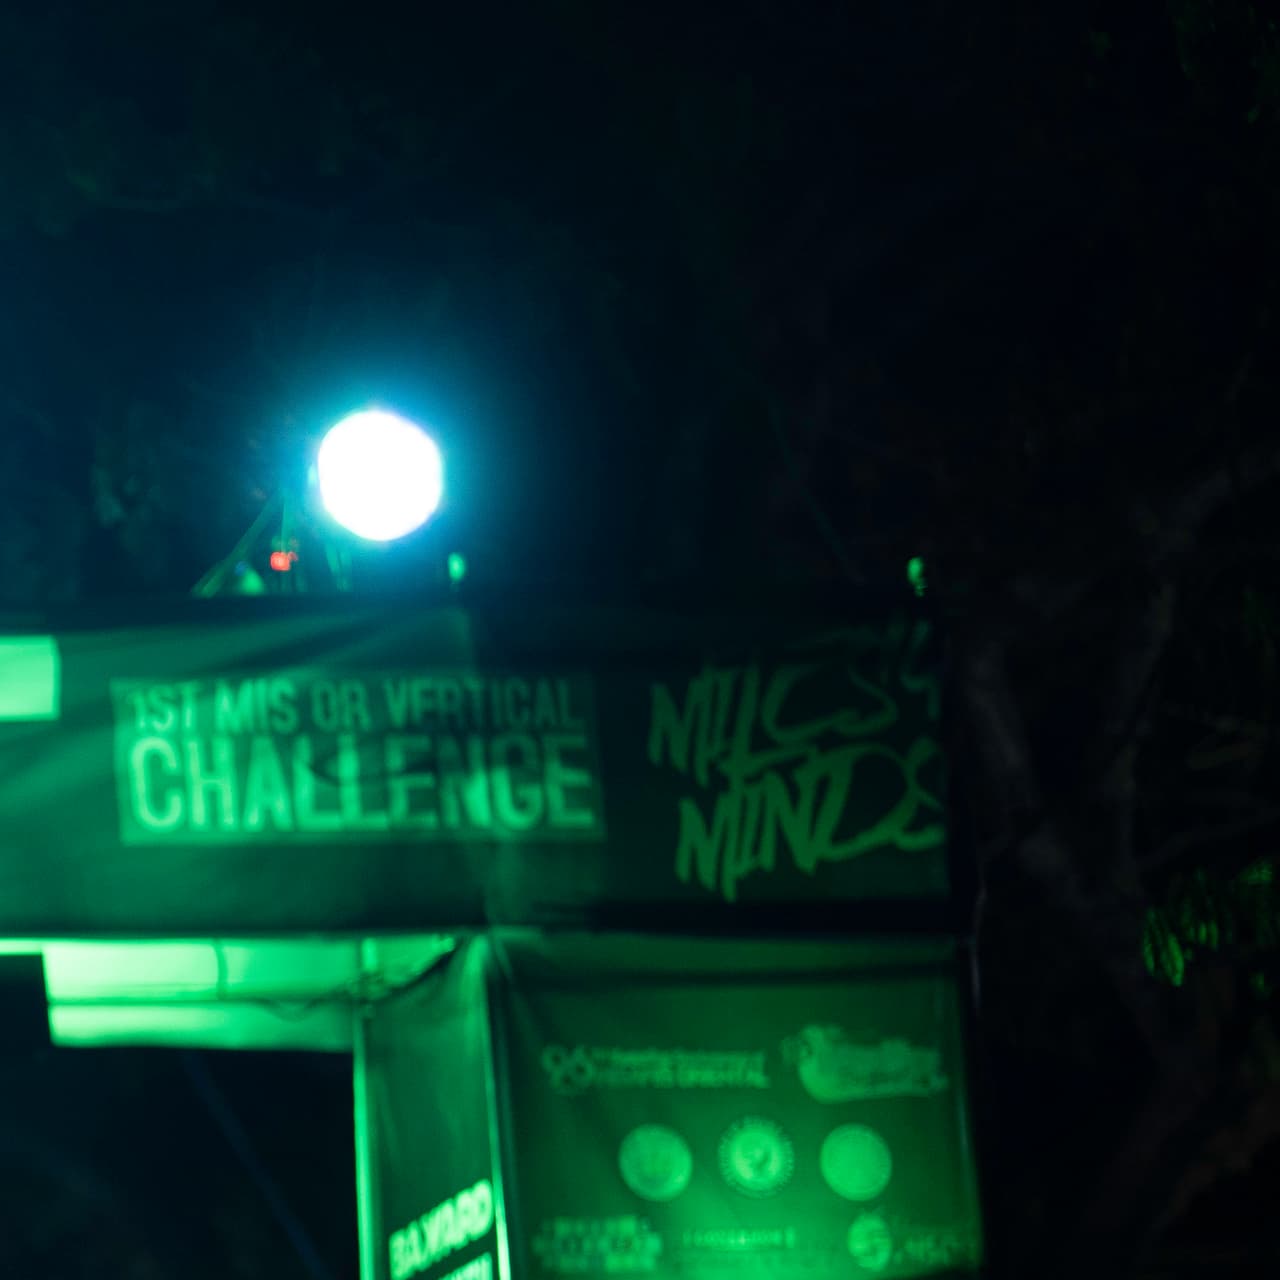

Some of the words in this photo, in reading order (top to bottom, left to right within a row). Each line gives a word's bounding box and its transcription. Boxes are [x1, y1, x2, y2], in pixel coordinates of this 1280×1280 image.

[131, 679, 201, 732] 1ST
[214, 679, 298, 733] MIS
[310, 679, 372, 732] OR
[383, 676, 583, 732] VERTICAL
[127, 734, 593, 832] CHALLENGE
